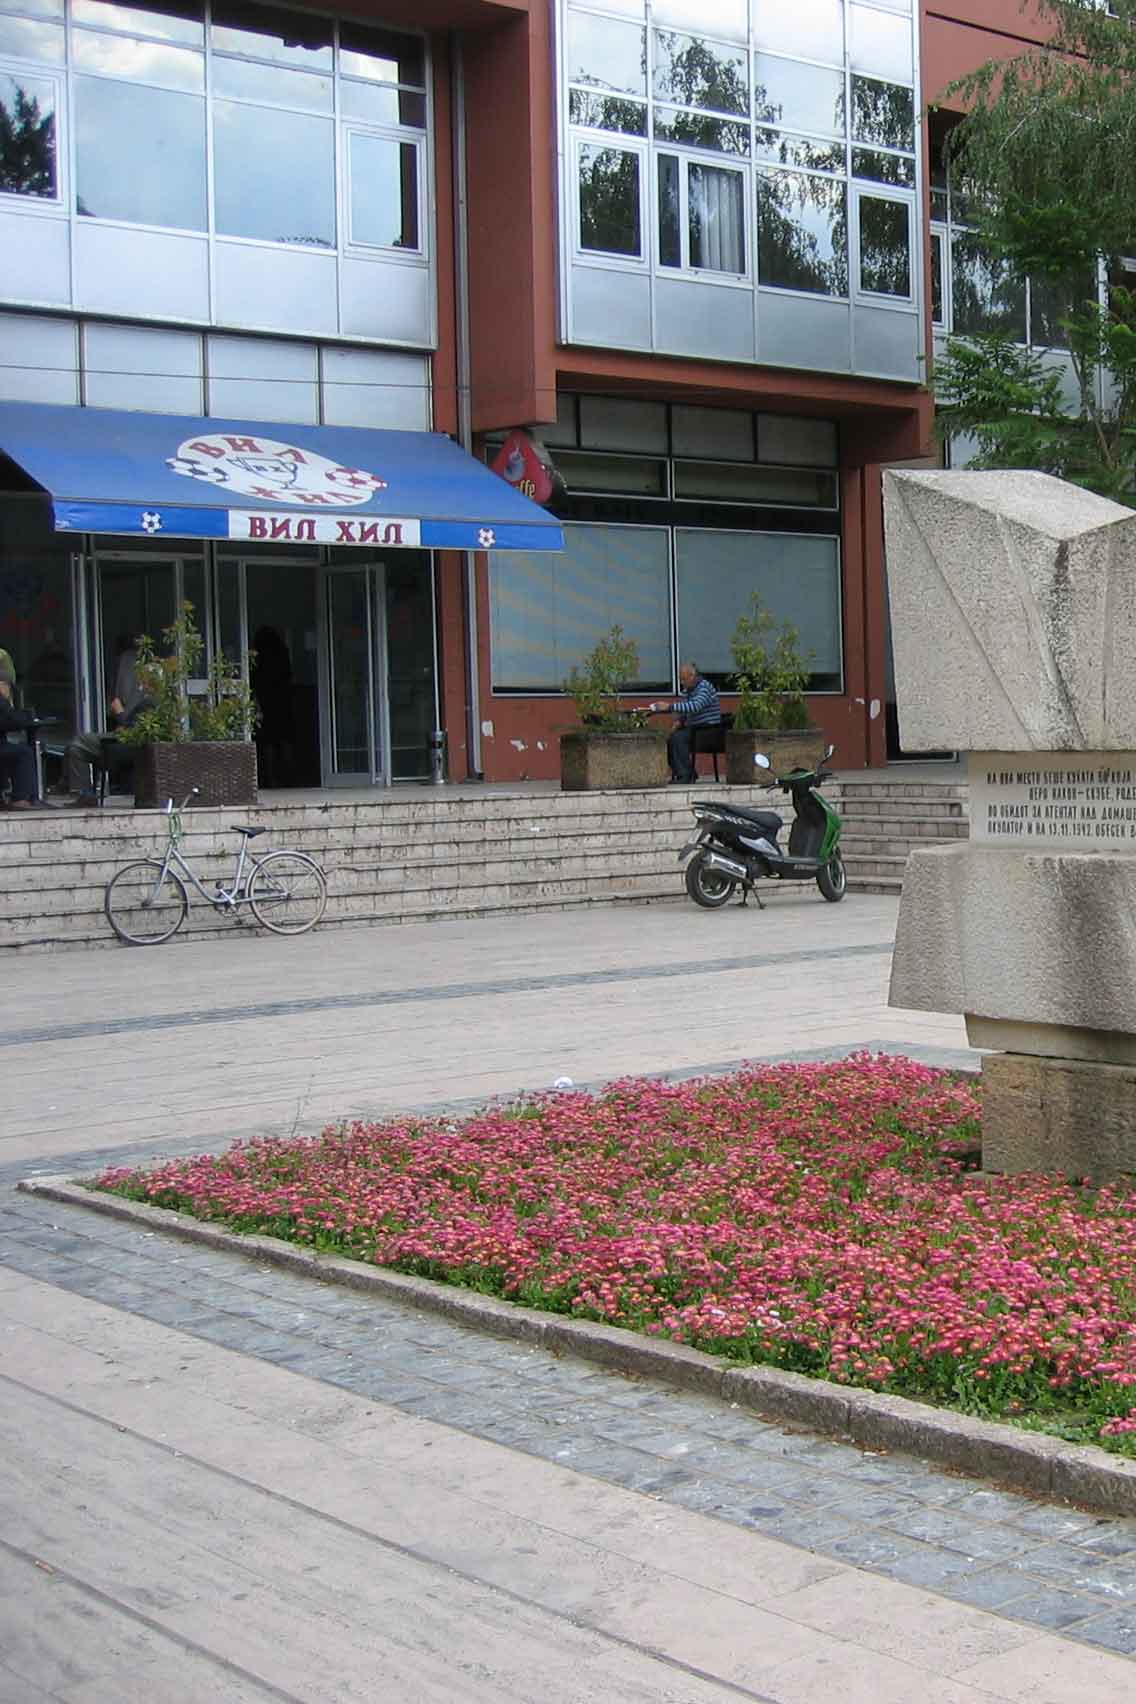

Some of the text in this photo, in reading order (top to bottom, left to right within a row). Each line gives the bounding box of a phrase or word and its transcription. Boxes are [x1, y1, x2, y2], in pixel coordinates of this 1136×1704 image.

[189, 437, 308, 464] ВИЛ
[245, 486, 363, 504] ХИЛ
[248, 516, 403, 544] ВИЛ ХИЛ
